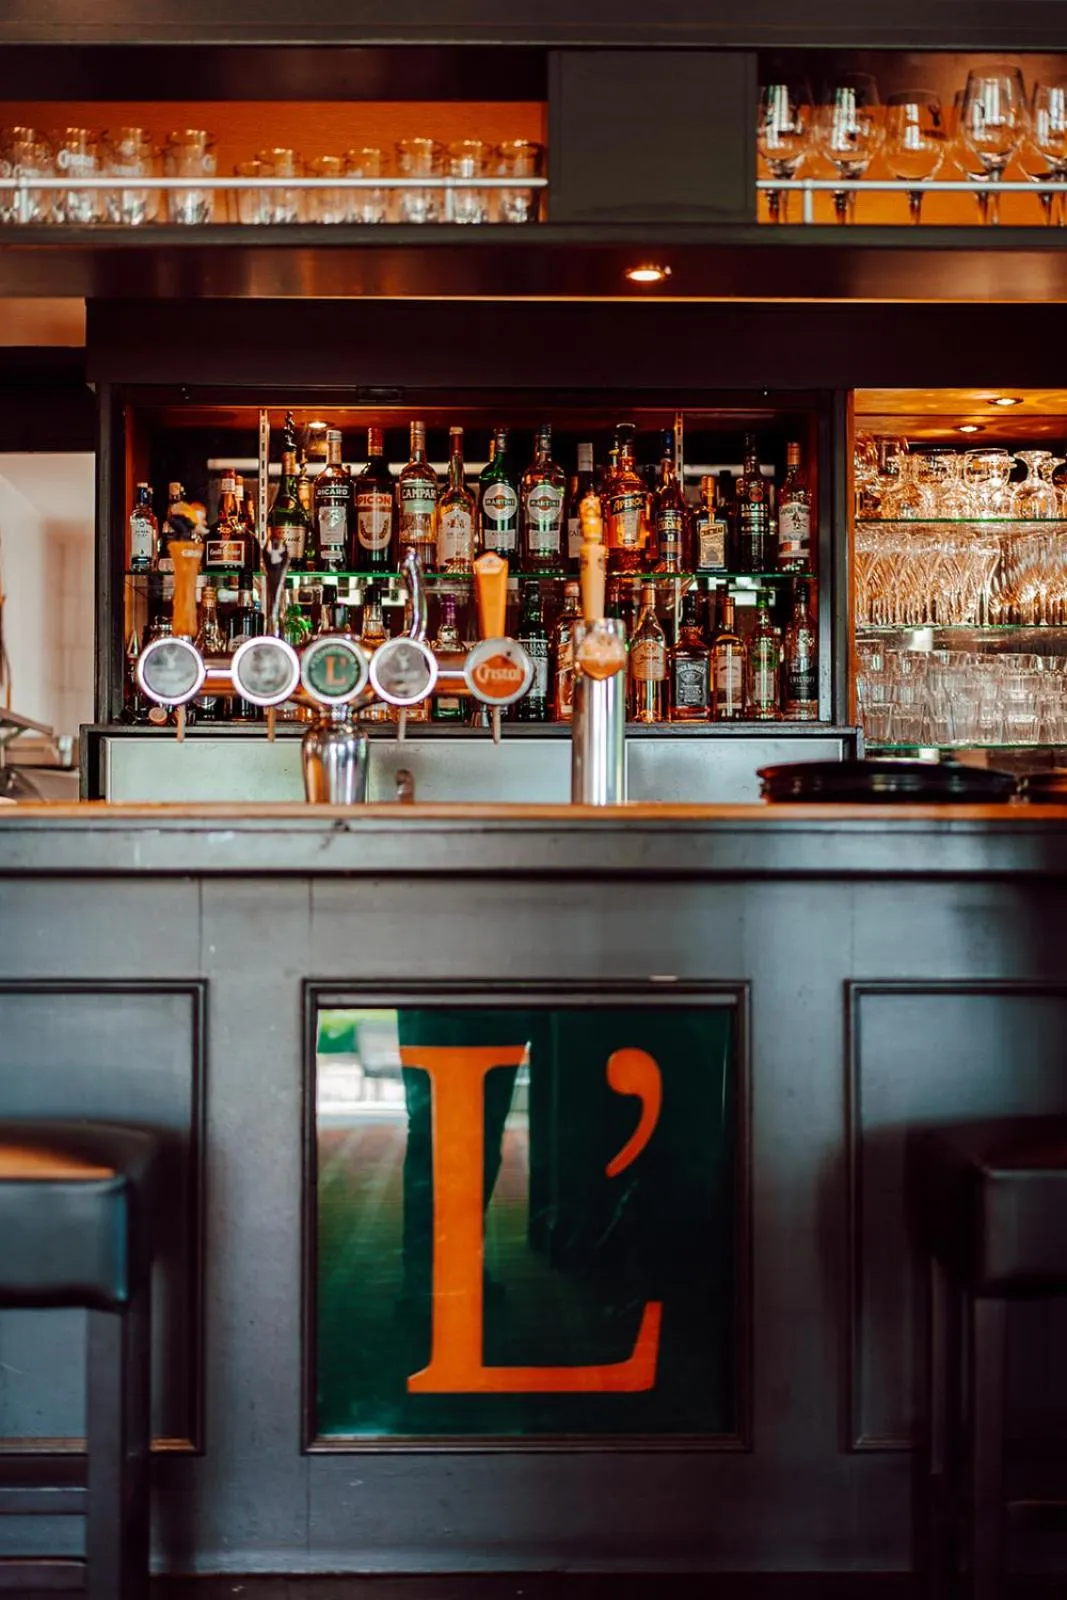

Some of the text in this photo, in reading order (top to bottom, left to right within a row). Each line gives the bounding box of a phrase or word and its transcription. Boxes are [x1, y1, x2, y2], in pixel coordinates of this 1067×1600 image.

[317, 488, 349, 496] RICARD
[357, 495, 391, 505] PICON
[325, 655, 348, 686] L'
[475, 662, 523, 684] Cristal
[399, 1045, 663, 1393] L'
